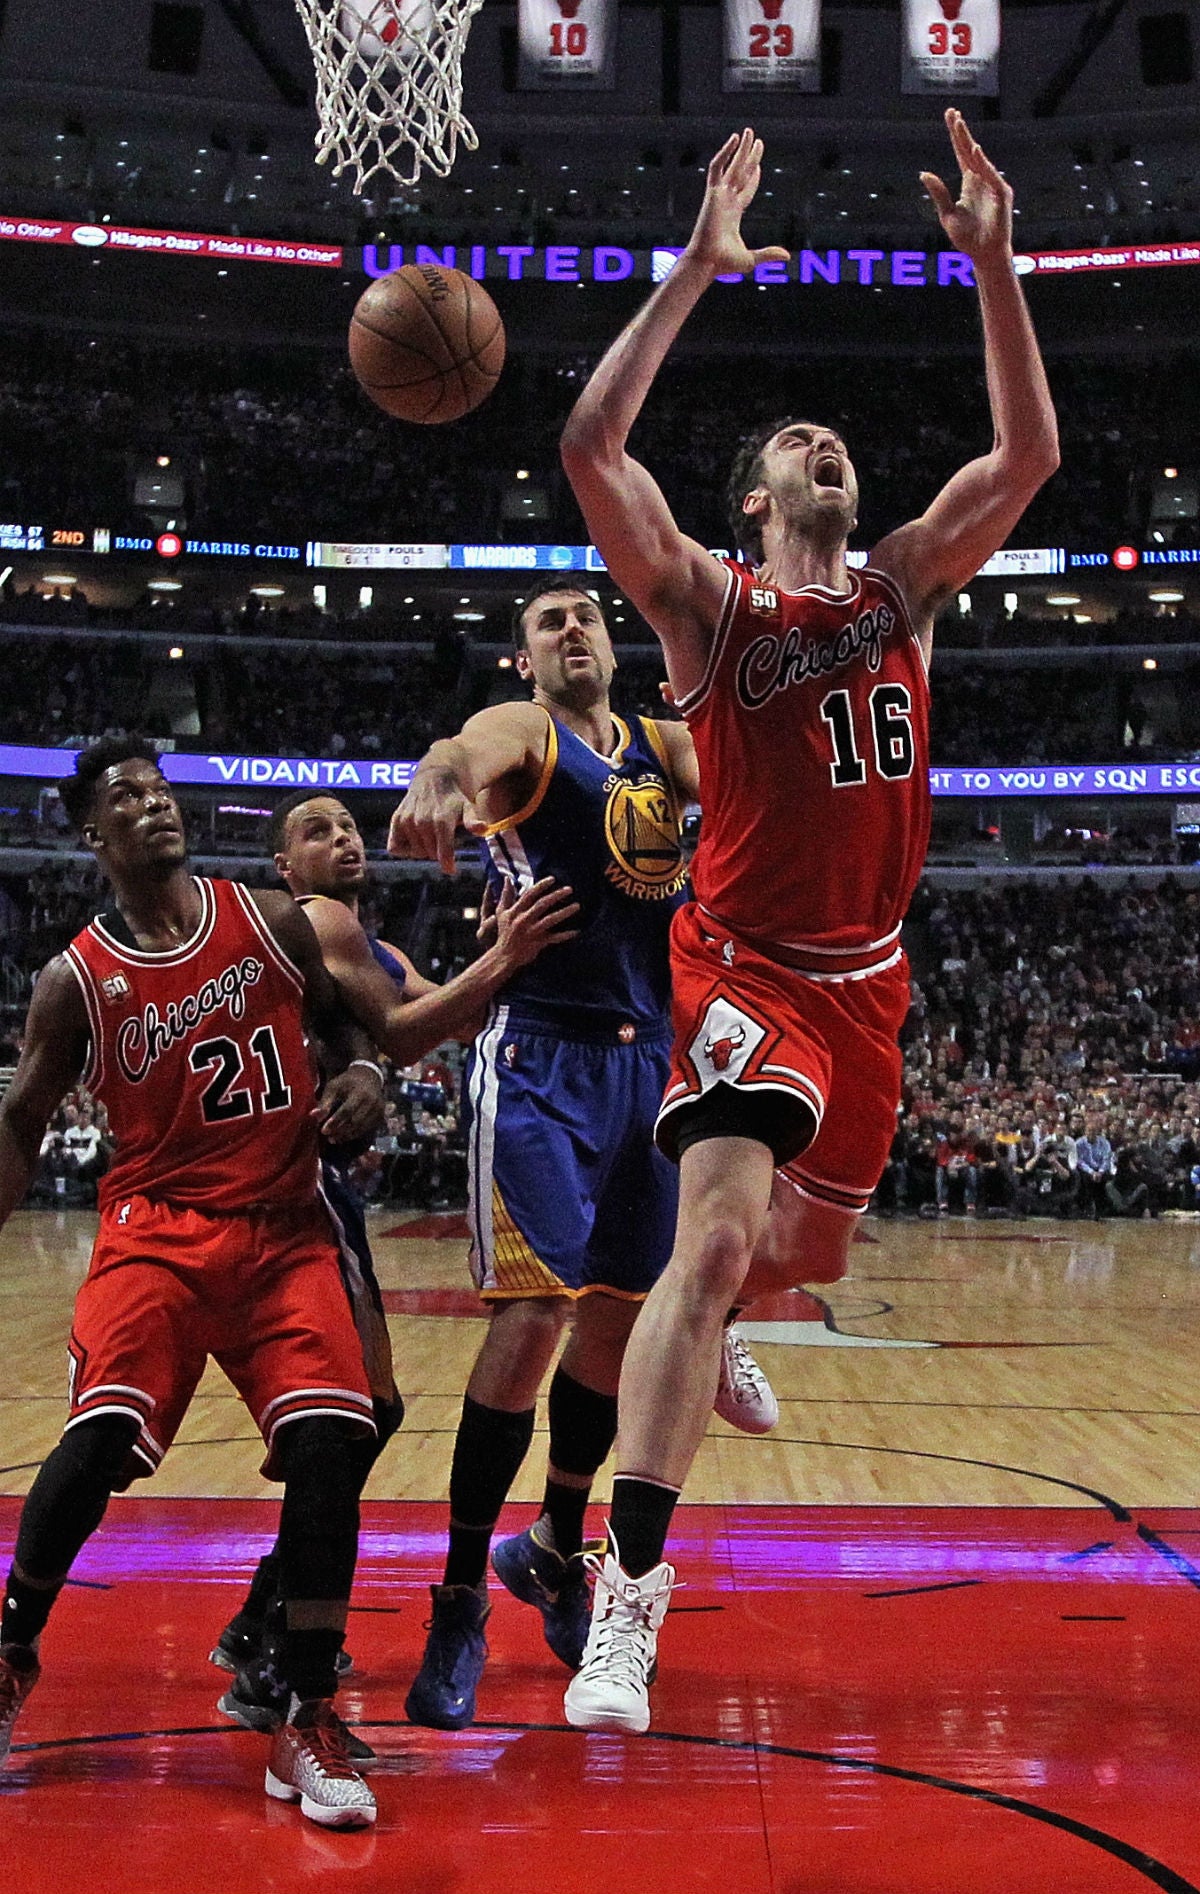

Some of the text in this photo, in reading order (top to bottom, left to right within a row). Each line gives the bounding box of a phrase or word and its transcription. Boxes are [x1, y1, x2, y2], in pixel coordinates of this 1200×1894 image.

[549, 23, 587, 56] 10
[749, 24, 793, 57] 23
[928, 23, 972, 56] 33
[208, 240, 245, 254] Made
[246, 244, 273, 257] Like
[274, 246, 296, 259] No
[1135, 249, 1171, 262] Made
[362, 244, 976, 287] UNITED ENTER
[51, 530, 84, 546] 2ND
[115, 536, 300, 559] BMO HARRIS CLUB
[462, 546, 538, 568] WARRIORS
[1070, 549, 1200, 567] BMO HARRI
[751, 588, 777, 610] 50
[736, 603, 896, 711] Chicago
[819, 682, 915, 789] 16
[207, 756, 418, 786] VIDANTA RE
[961, 772, 991, 789] TO
[999, 771, 1046, 789] YOU
[1053, 772, 1085, 788] BY
[1093, 768, 1148, 792] SQN
[647, 799, 673, 824] 12
[603, 860, 692, 900] WARRIOR
[101, 974, 130, 998] 50
[116, 956, 265, 1085] Chicago
[188, 1024, 292, 1126] 21
